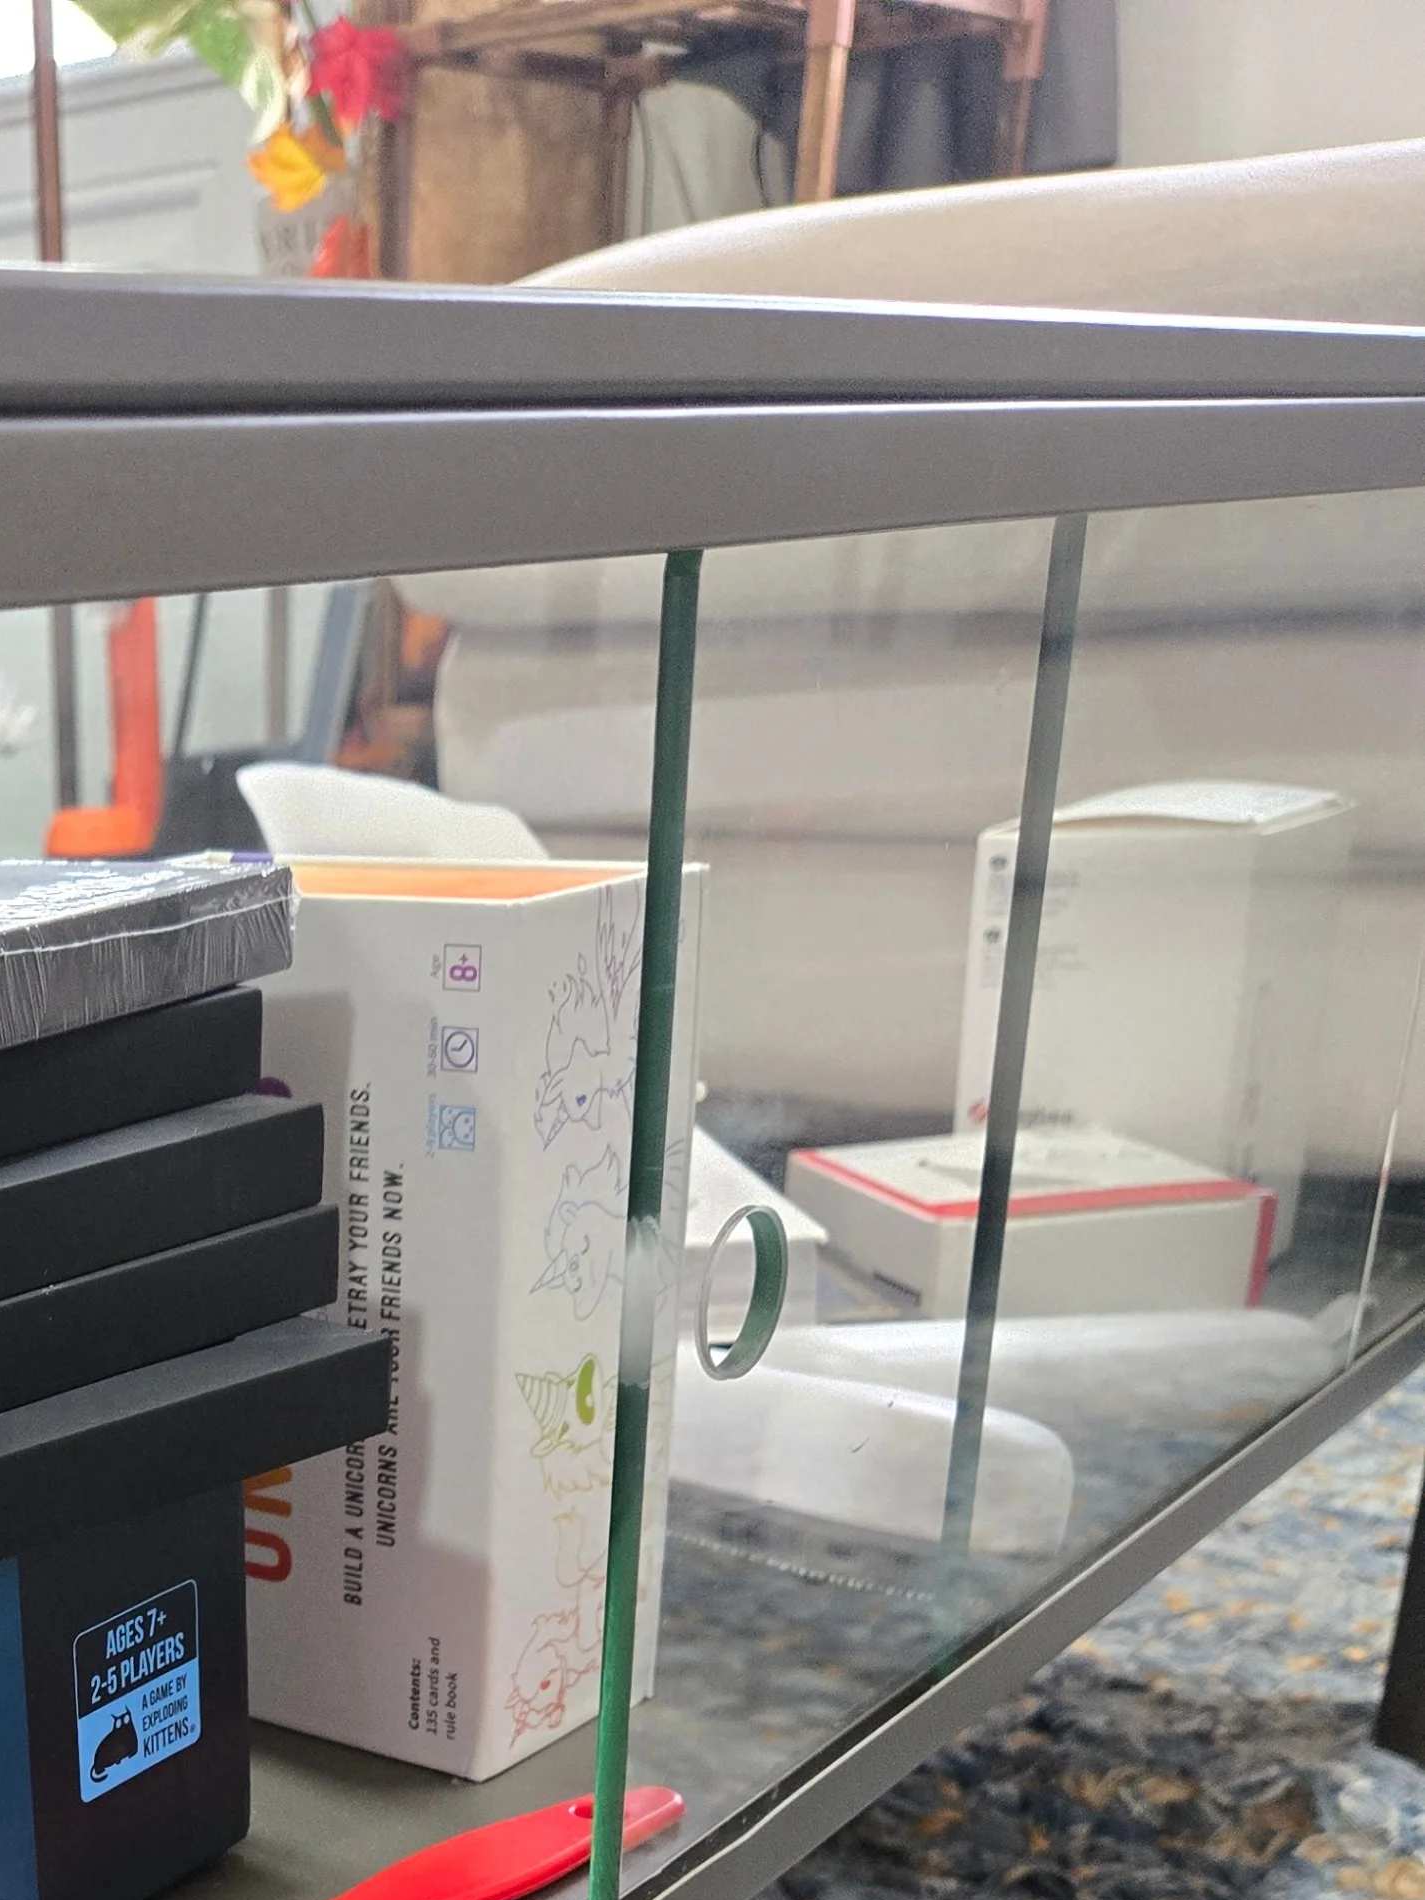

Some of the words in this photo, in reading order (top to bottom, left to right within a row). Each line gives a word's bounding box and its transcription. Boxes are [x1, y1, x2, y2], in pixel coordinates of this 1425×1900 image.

[449, 953, 478, 982] 8+
[349, 1082, 371, 1182] FRIENDS.
[383, 1162, 405, 1221] NOW.
[348, 1192, 370, 1253] YOUR
[380, 1231, 403, 1320] FRIENDS
[345, 1440, 365, 1517] UNICOR
[376, 1444, 398, 1548] UNICORNS
[344, 1526, 364, 1540] A
[343, 1547, 363, 1606] BUILD
[106, 1615, 144, 1660] AGES
[147, 1607, 167, 1638] 7+
[428, 1637, 440, 1665] and
[91, 1665, 118, 1704] 2-5
[120, 1632, 185, 1689] PLAYERS
[142, 1694, 149, 1711] A
[150, 1683, 175, 1708] GAME
[176, 1673, 188, 1694] BY
[408, 1658, 421, 1730] Contents:
[427, 1668, 440, 1707] cards
[445, 1672, 457, 1708] book
[142, 1696, 189, 1732] EXPLODING
[426, 1709, 438, 1736] 135
[443, 1711, 456, 1740] rule
